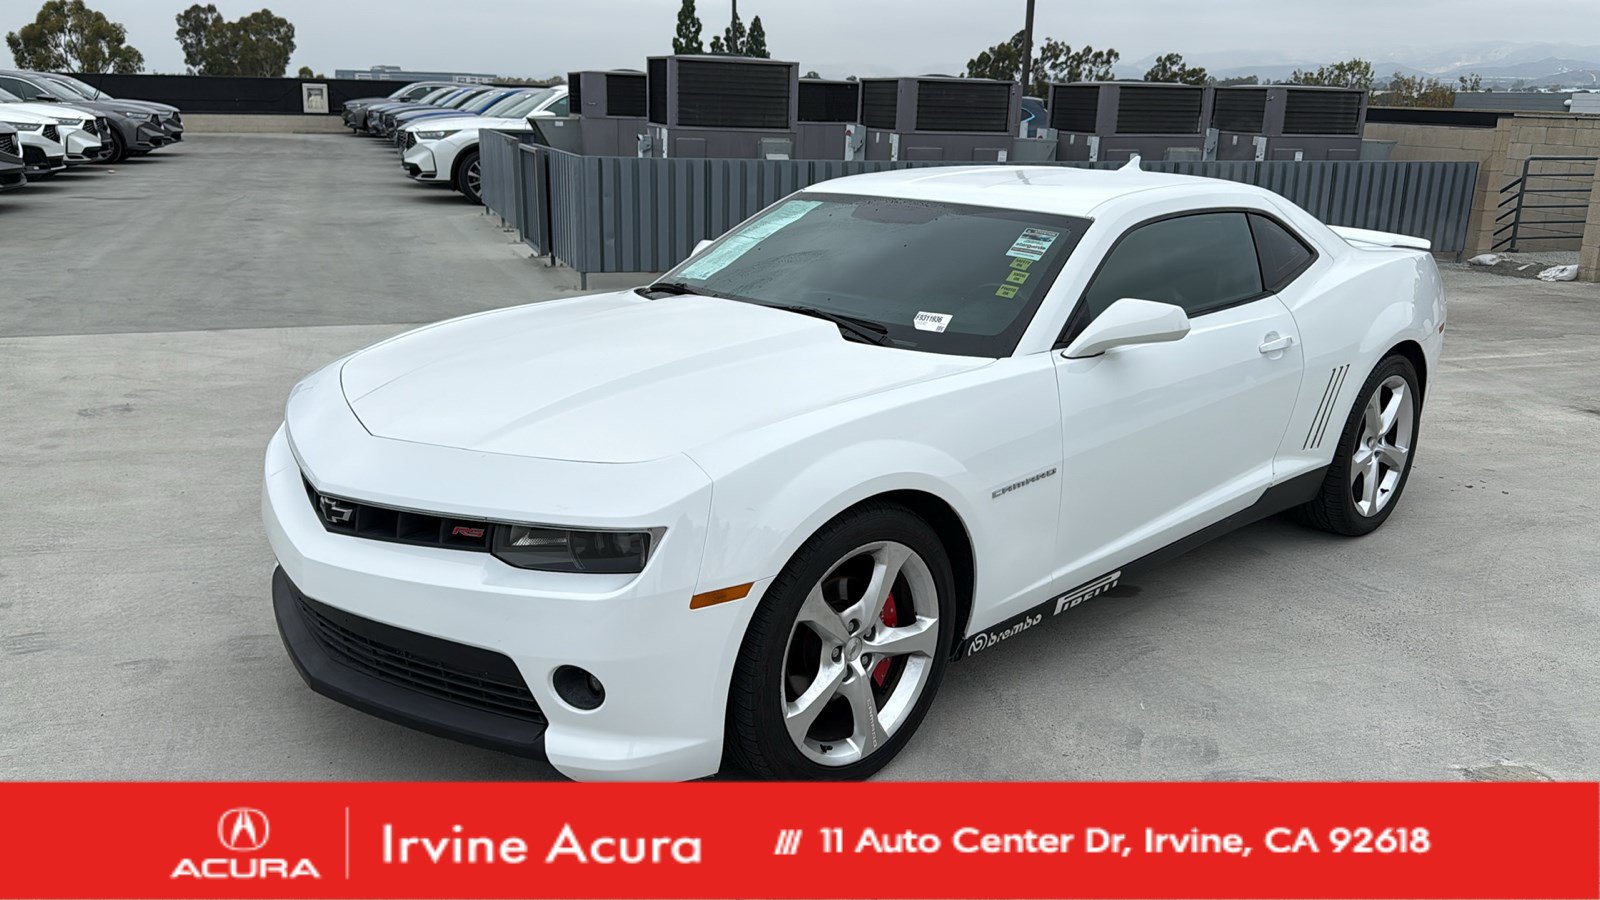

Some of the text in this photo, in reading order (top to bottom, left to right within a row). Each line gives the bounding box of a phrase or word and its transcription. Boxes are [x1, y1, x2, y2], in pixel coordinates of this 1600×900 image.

[992, 467, 1057, 499] CAMARO
[452, 526, 485, 537] RS
[1053, 570, 1122, 617] PIRELLI
[986, 613, 1043, 648] brembo
